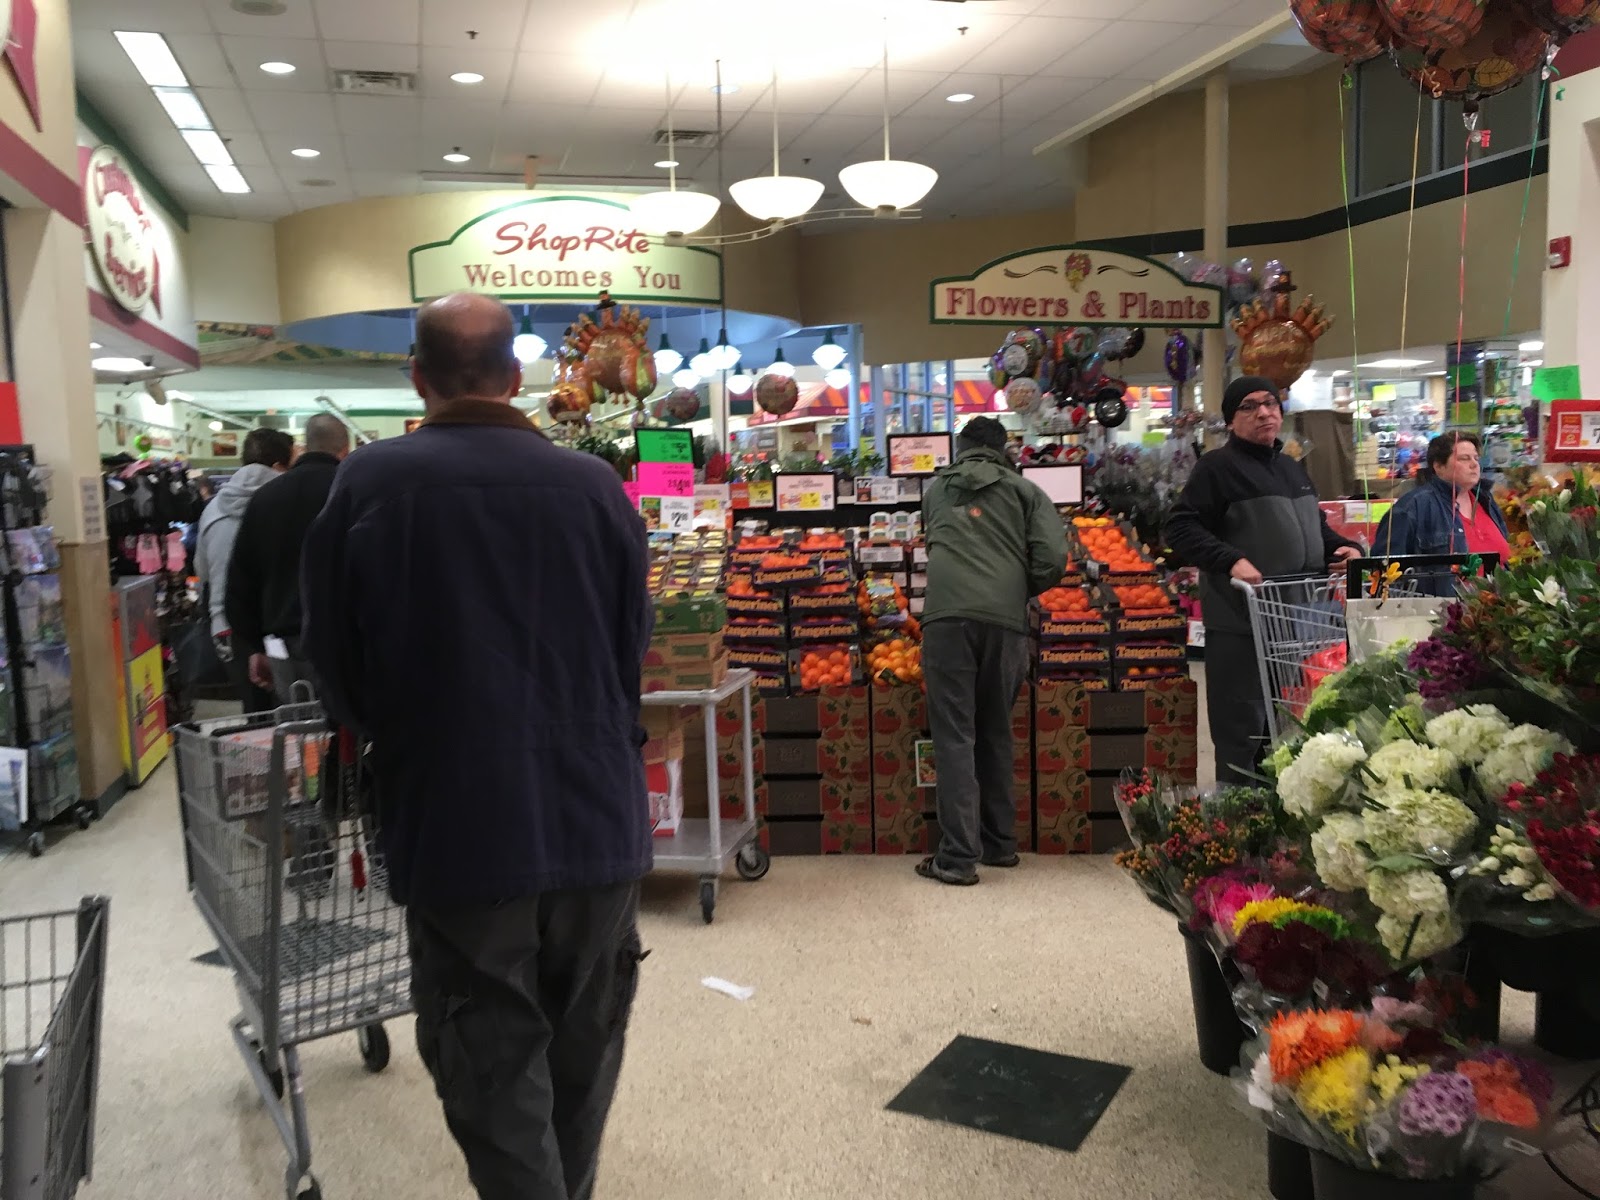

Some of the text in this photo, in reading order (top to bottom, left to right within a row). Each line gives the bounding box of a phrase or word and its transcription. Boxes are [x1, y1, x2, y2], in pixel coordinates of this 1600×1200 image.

[493, 221, 651, 261] ShopRite
[462, 264, 682, 290] Welcomes You
[945, 287, 1212, 320] Flowers & Plants
[726, 598, 780, 611] angerines
[1041, 621, 1106, 636] Tangerines
[1118, 617, 1182, 631] Tangerines
[728, 651, 782, 664] angerines
[1040, 650, 1105, 663] Tangerines
[1116, 645, 1180, 659] Tangerines
